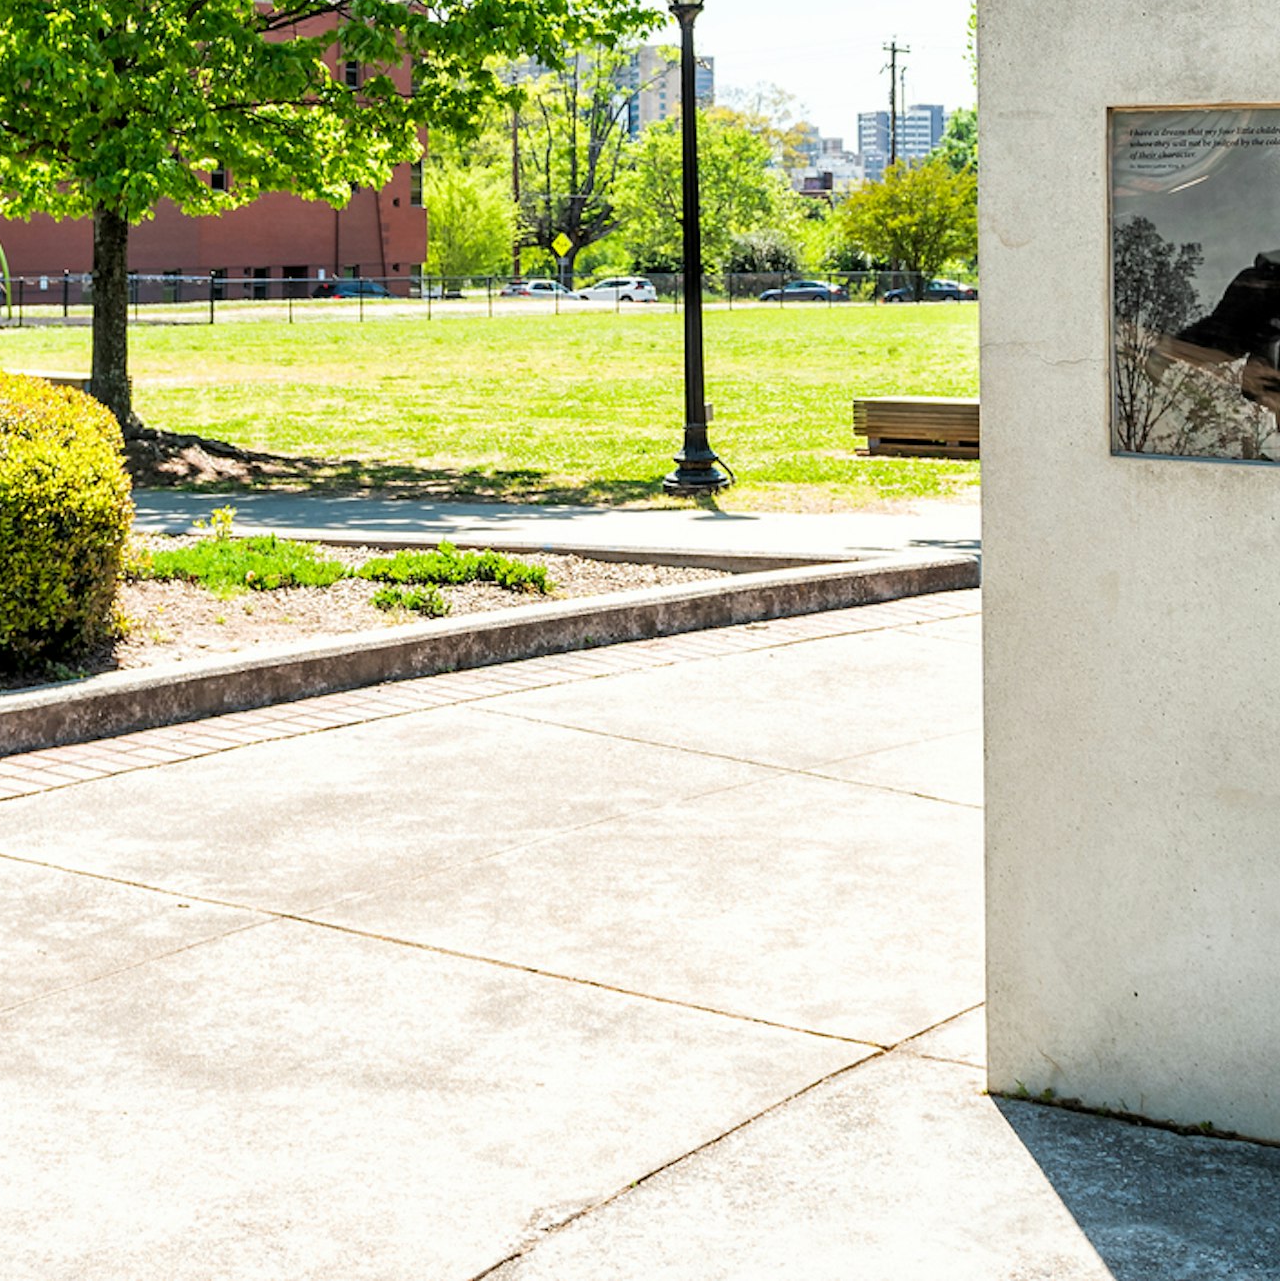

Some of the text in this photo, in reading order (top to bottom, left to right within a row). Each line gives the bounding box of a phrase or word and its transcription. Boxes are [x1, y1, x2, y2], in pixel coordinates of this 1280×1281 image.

[1134, 128, 1153, 136] have
[1161, 127, 1186, 136] dream
[1187, 127, 1203, 136] that
[1205, 129, 1217, 138] my
[1217, 126, 1235, 138] four
[1130, 139, 1153, 148] where
[1153, 139, 1170, 149] they
[1172, 139, 1187, 147] will
[1188, 139, 1201, 147] not
[1202, 138, 1211, 147] be
[1240, 138, 1250, 149] by
[1251, 137, 1264, 146] the
[1129, 151, 1139, 160] of
